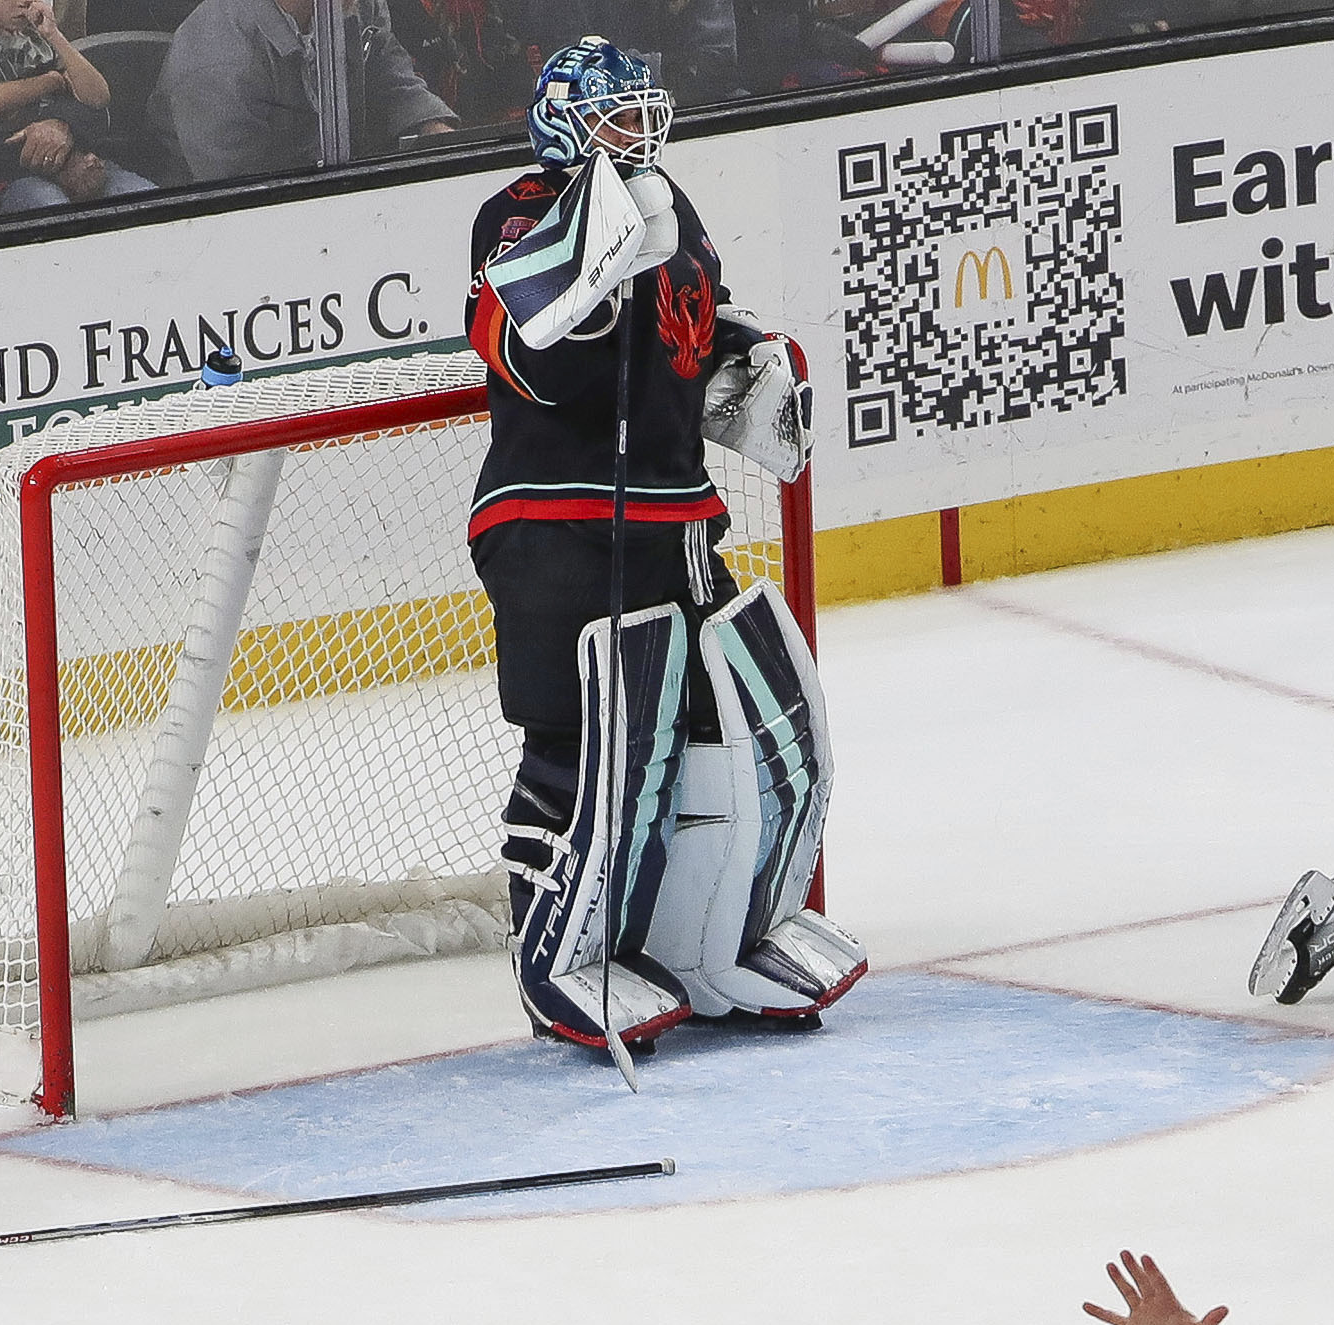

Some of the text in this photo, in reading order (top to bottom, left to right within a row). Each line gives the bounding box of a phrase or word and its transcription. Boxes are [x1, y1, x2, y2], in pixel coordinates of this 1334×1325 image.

[587, 222, 637, 289] TRUE
[79, 290, 345, 390] FRANCES
[367, 271, 430, 341] C.
[1184, 375, 1246, 395] participating
[531, 850, 581, 966] TRUE
